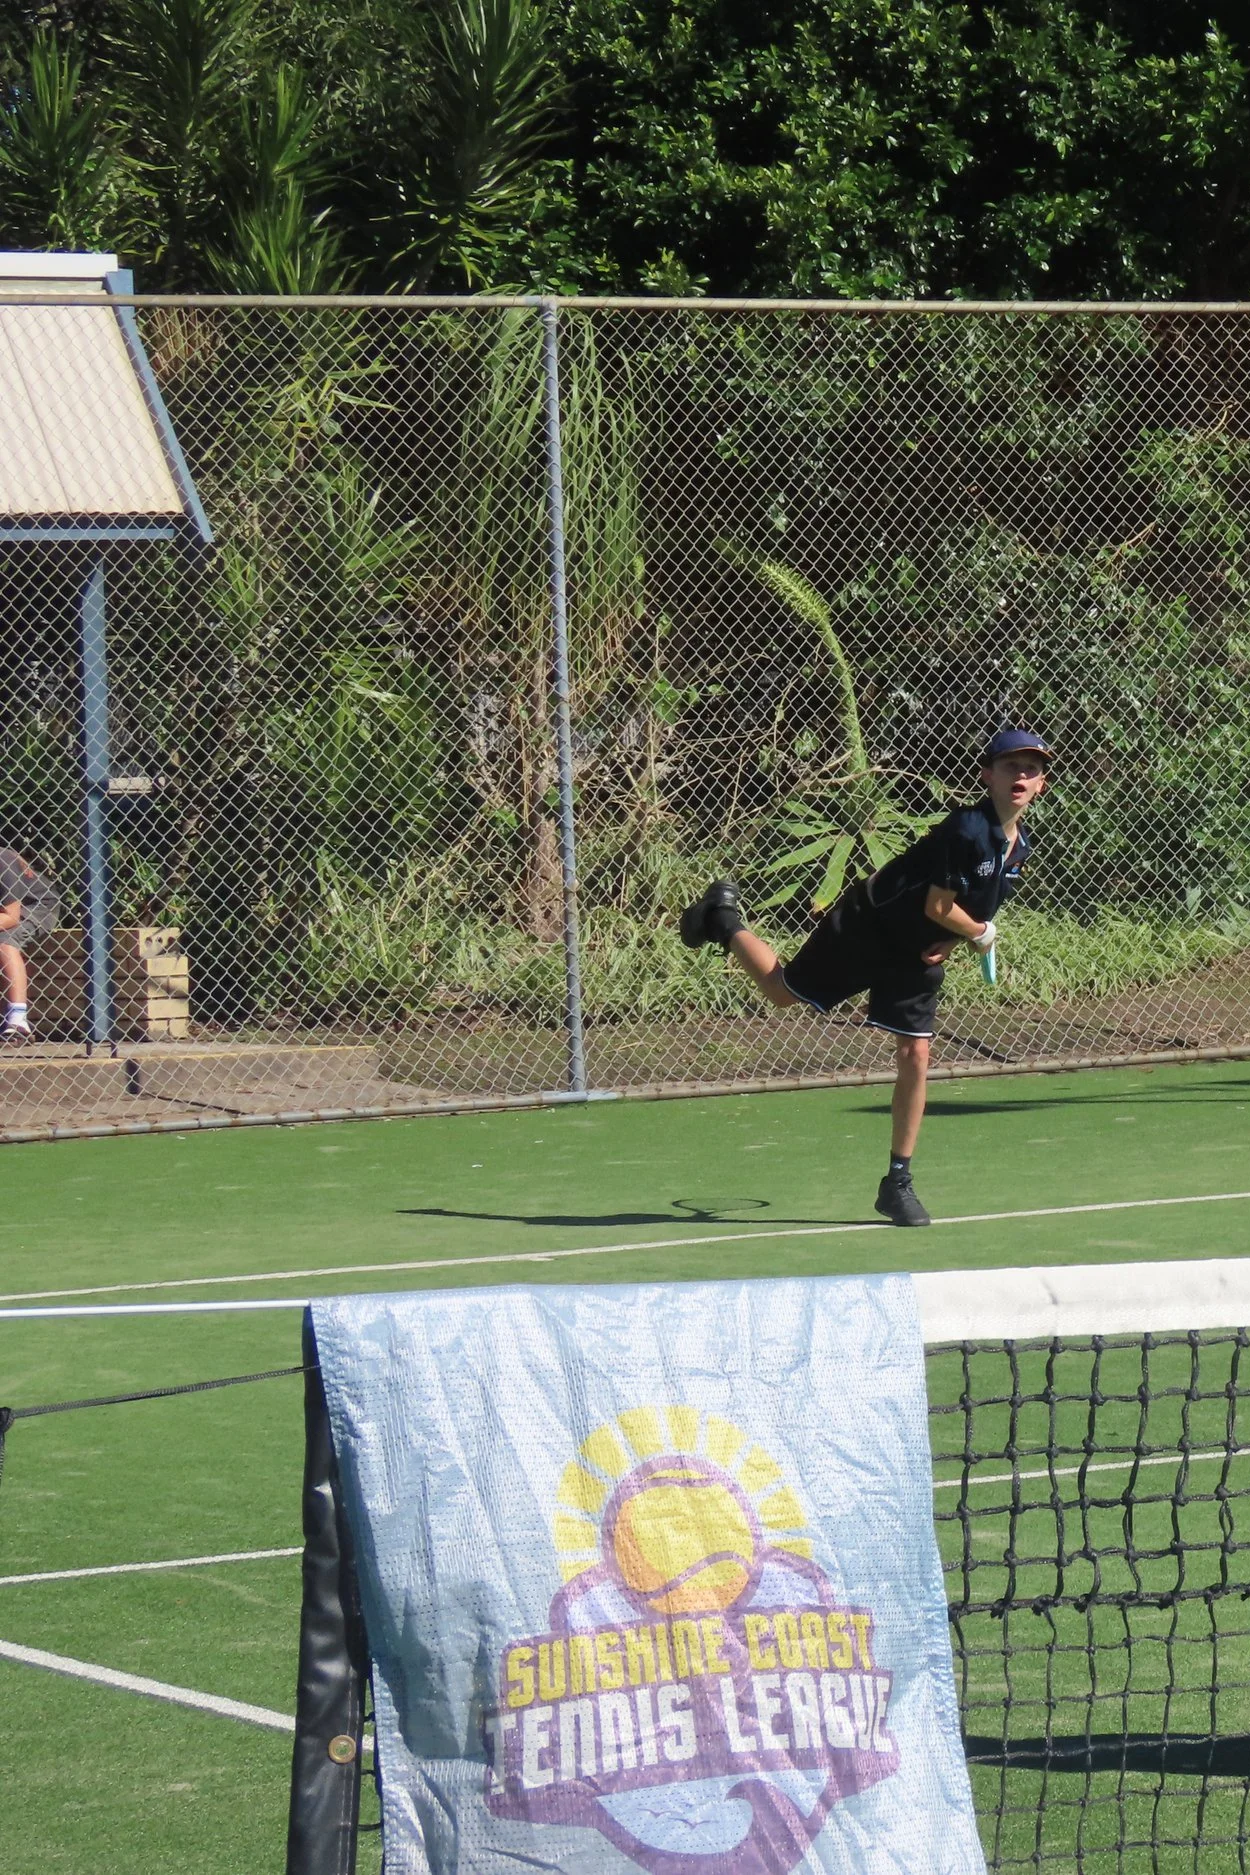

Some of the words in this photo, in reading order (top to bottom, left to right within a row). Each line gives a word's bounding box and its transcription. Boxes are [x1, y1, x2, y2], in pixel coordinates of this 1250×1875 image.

[507, 1618, 731, 1708] SUNSHINE
[744, 1612, 874, 1670] COAST
[485, 1683, 699, 1795] TENNIS
[719, 1672, 893, 1753] LEAGUE
